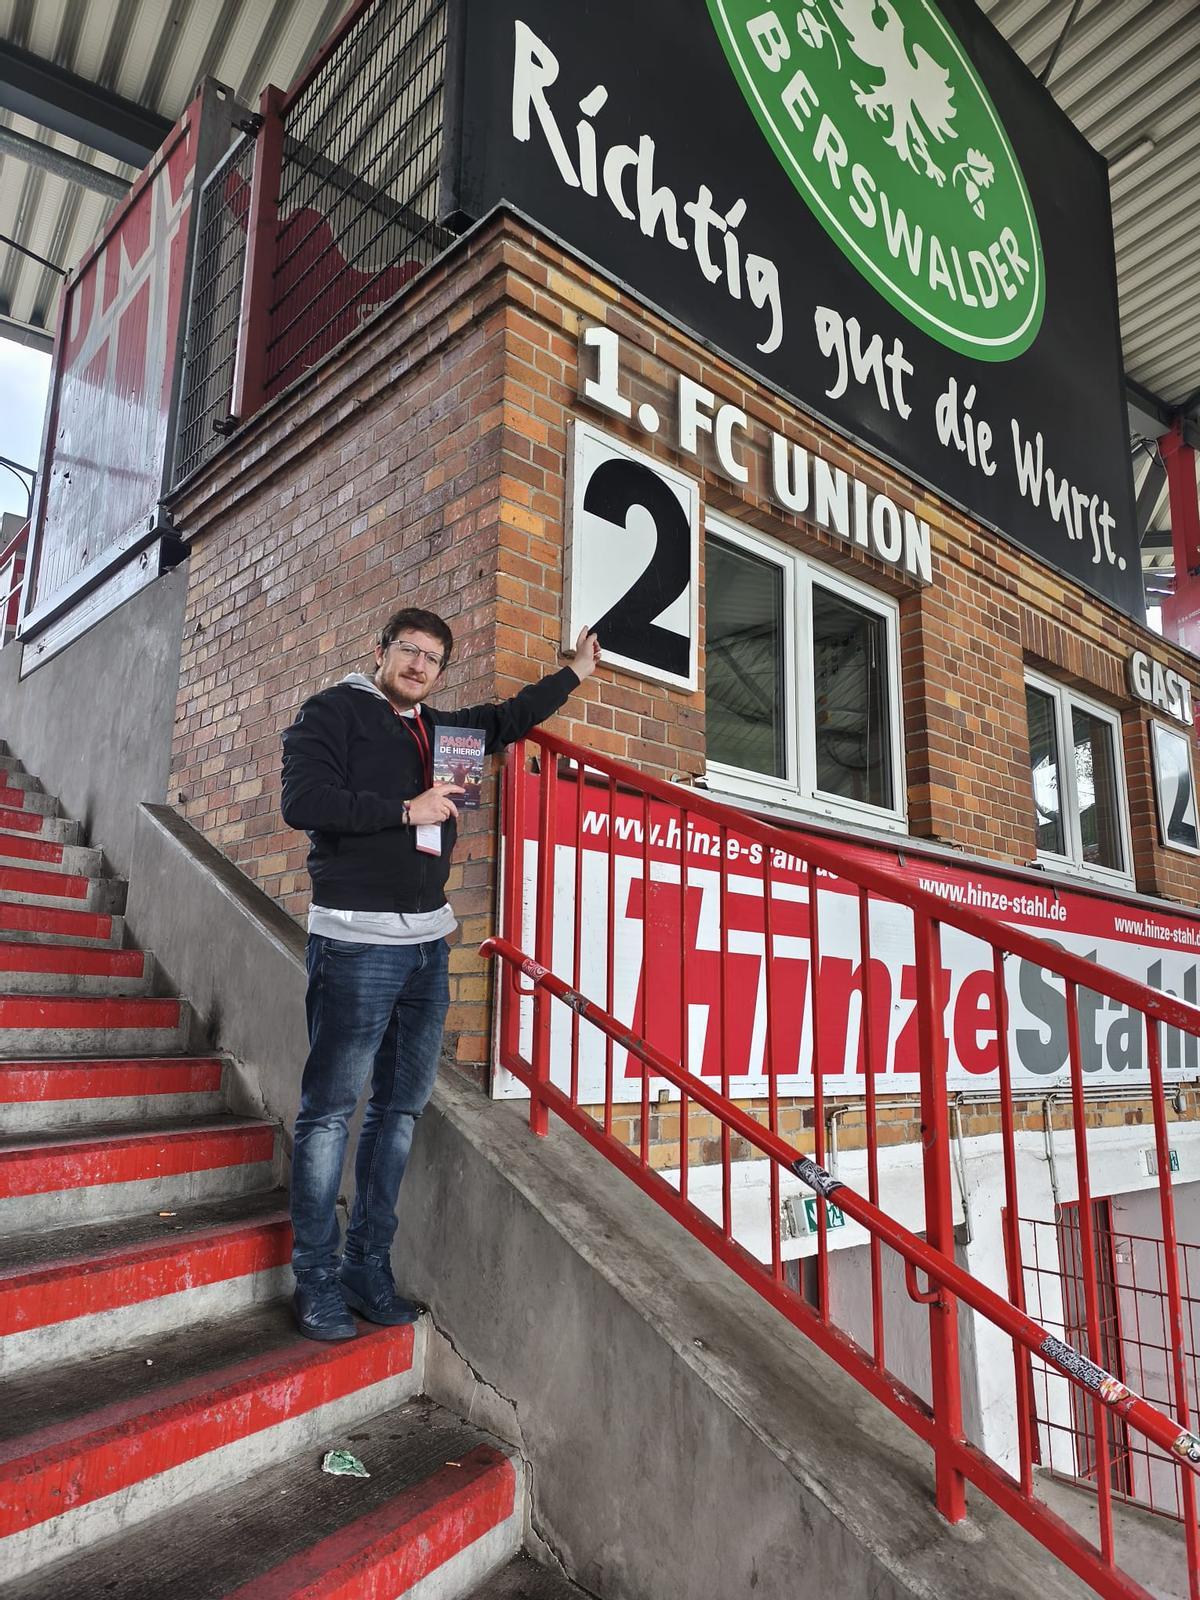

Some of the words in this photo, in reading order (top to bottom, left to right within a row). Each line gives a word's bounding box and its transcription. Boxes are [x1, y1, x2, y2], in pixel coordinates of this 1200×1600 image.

[746, 0, 1030, 309] BERSWALDER
[512, 19, 784, 354] Richtig
[814, 305, 914, 420] gut
[935, 377, 997, 477] die
[1011, 418, 1127, 571] Wurst.
[584, 326, 661, 433] 1.
[679, 373, 749, 483] FC
[771, 430, 933, 587] UNION
[583, 457, 691, 680] 2
[440, 735, 481, 748] PASIÓN
[1131, 650, 1194, 726] GAST
[440, 746, 451, 754] DE
[453, 747, 481, 757] HIERRO
[1159, 732, 1197, 848] 2
[918, 877, 1067, 922] www.hinze-stahl.de
